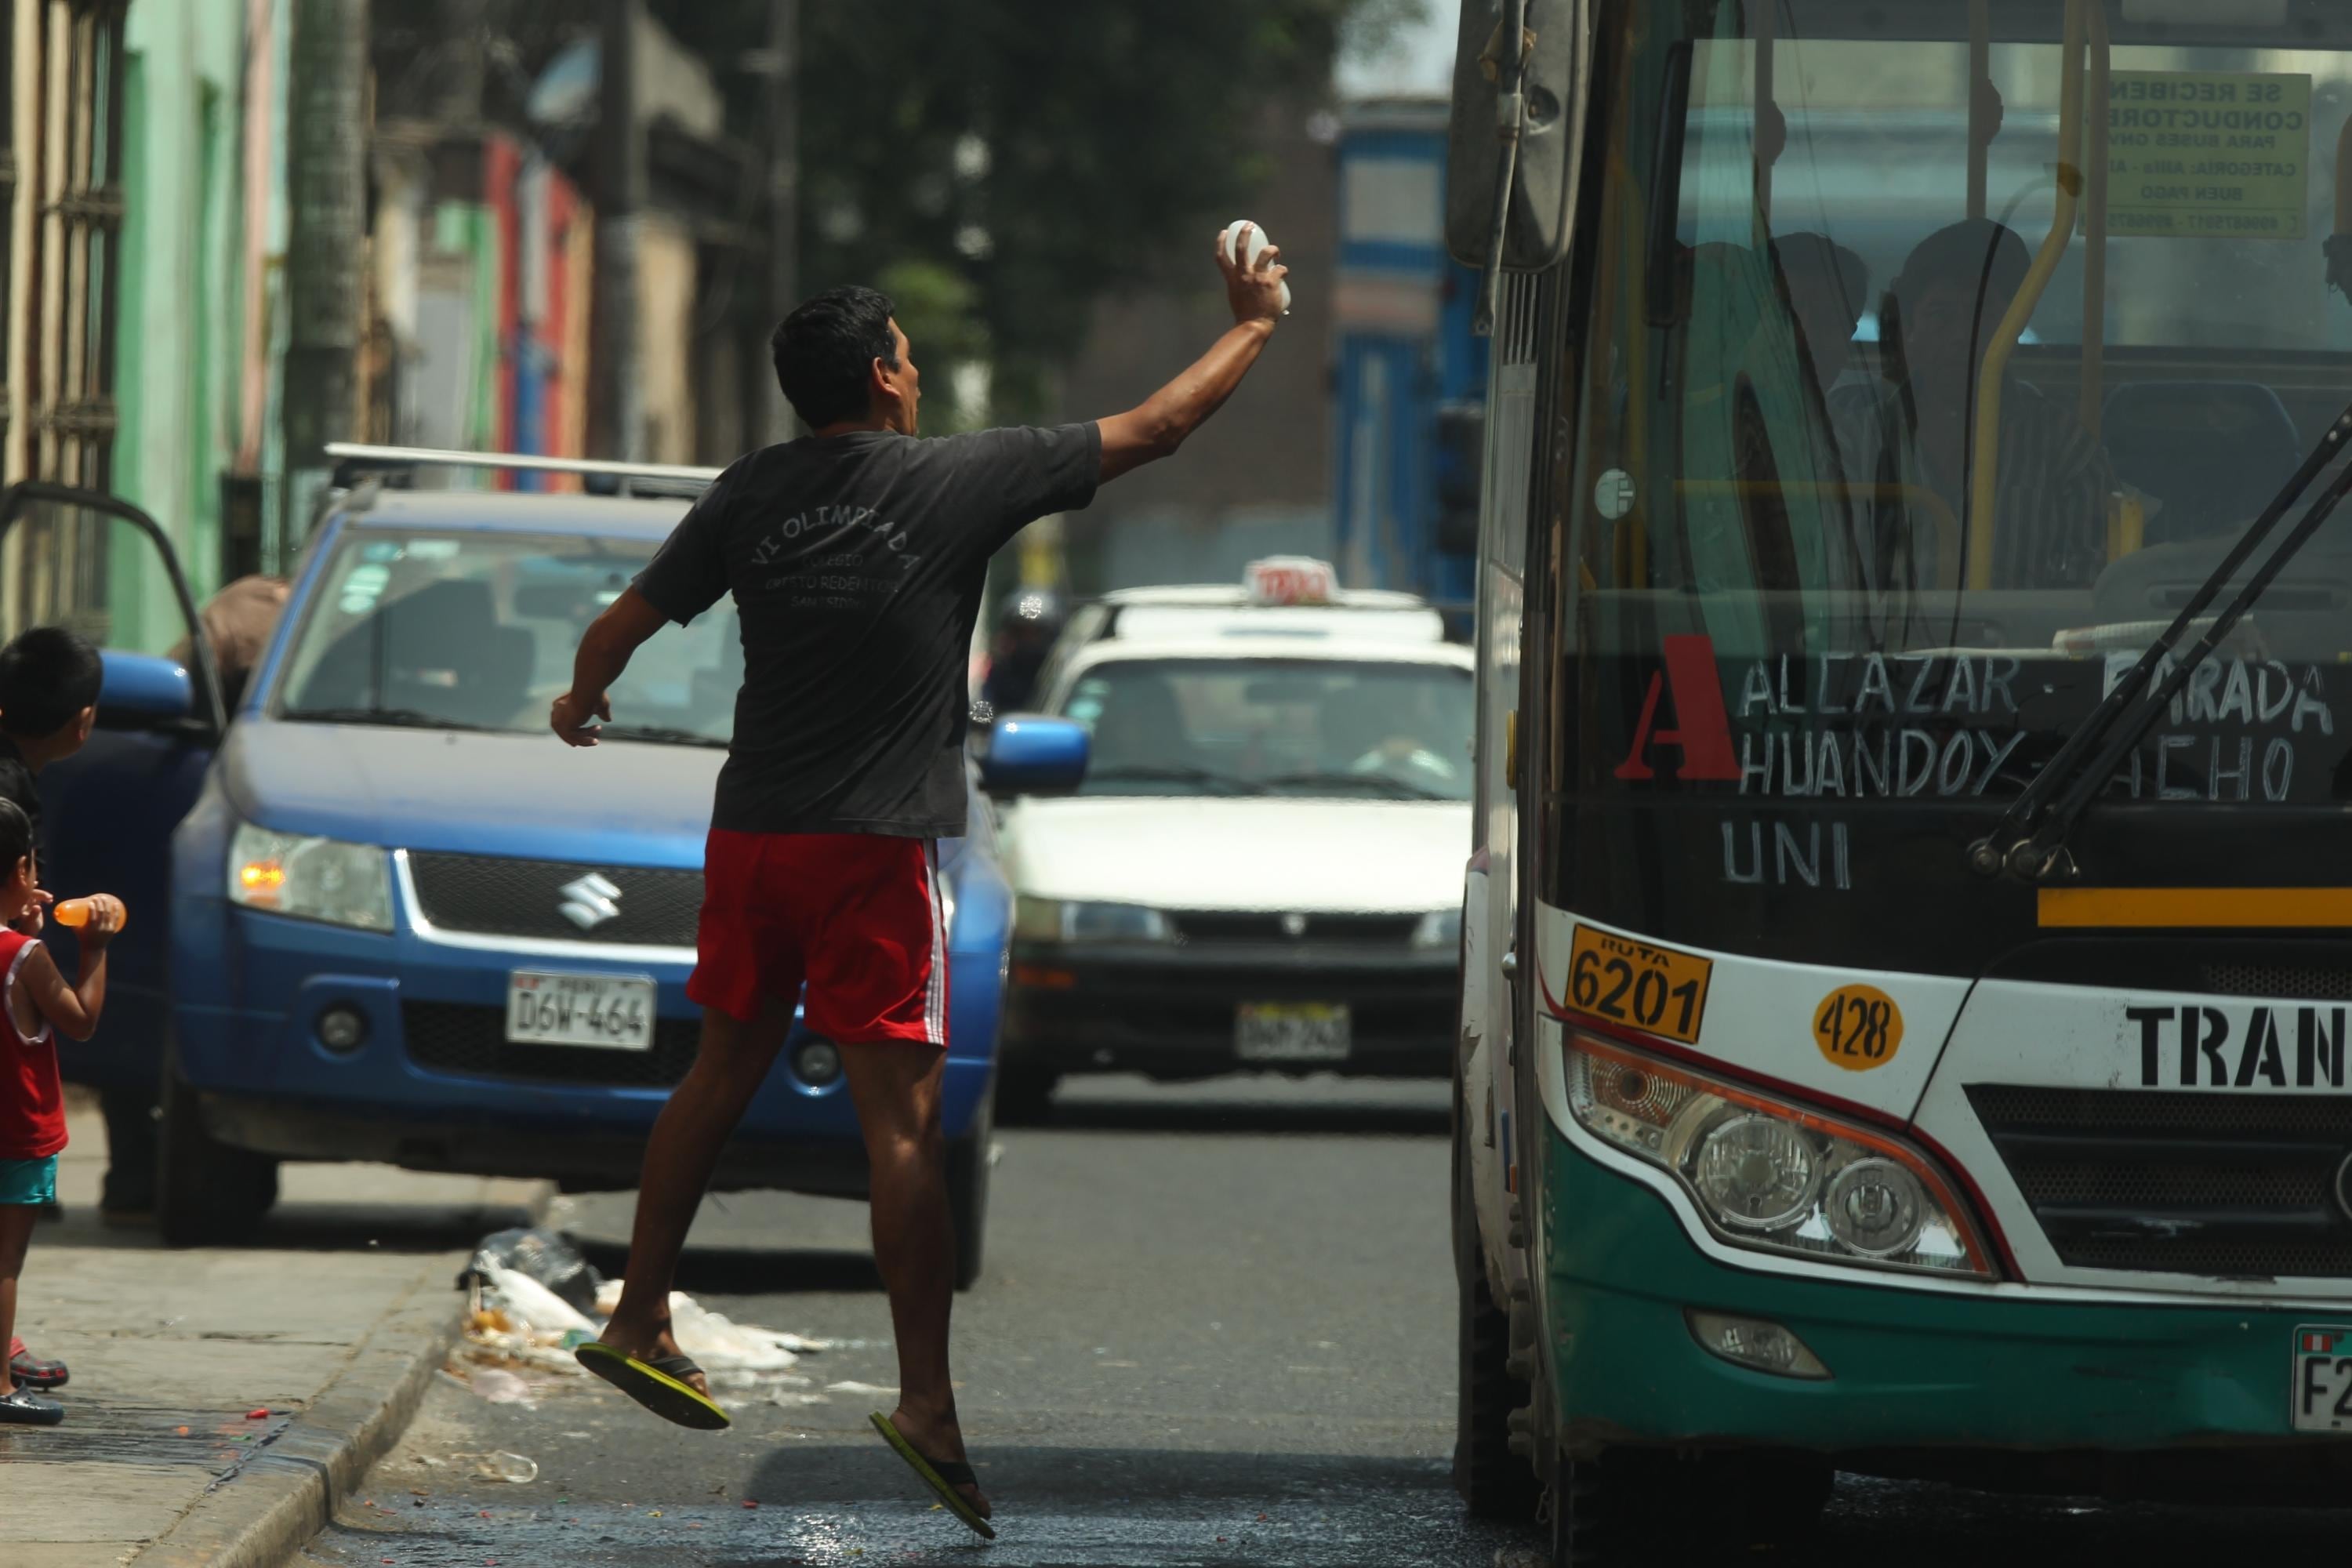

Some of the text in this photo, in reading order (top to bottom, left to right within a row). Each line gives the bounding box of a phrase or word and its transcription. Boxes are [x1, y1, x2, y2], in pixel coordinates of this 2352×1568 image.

[750, 503, 921, 571] VI OLIMPIADA
[1613, 634, 1744, 779] A
[1736, 652, 2022, 717] ALCAZAR
[2102, 649, 2334, 735] PARADA
[1738, 729, 2027, 797] HUANDOY
[1720, 822, 1852, 890] UNI
[1600, 937, 1671, 967] RUTA
[1572, 949, 1700, 1035] 6201
[1818, 993, 1891, 1059] 428
[2125, 1006, 2347, 1087] TRAN
